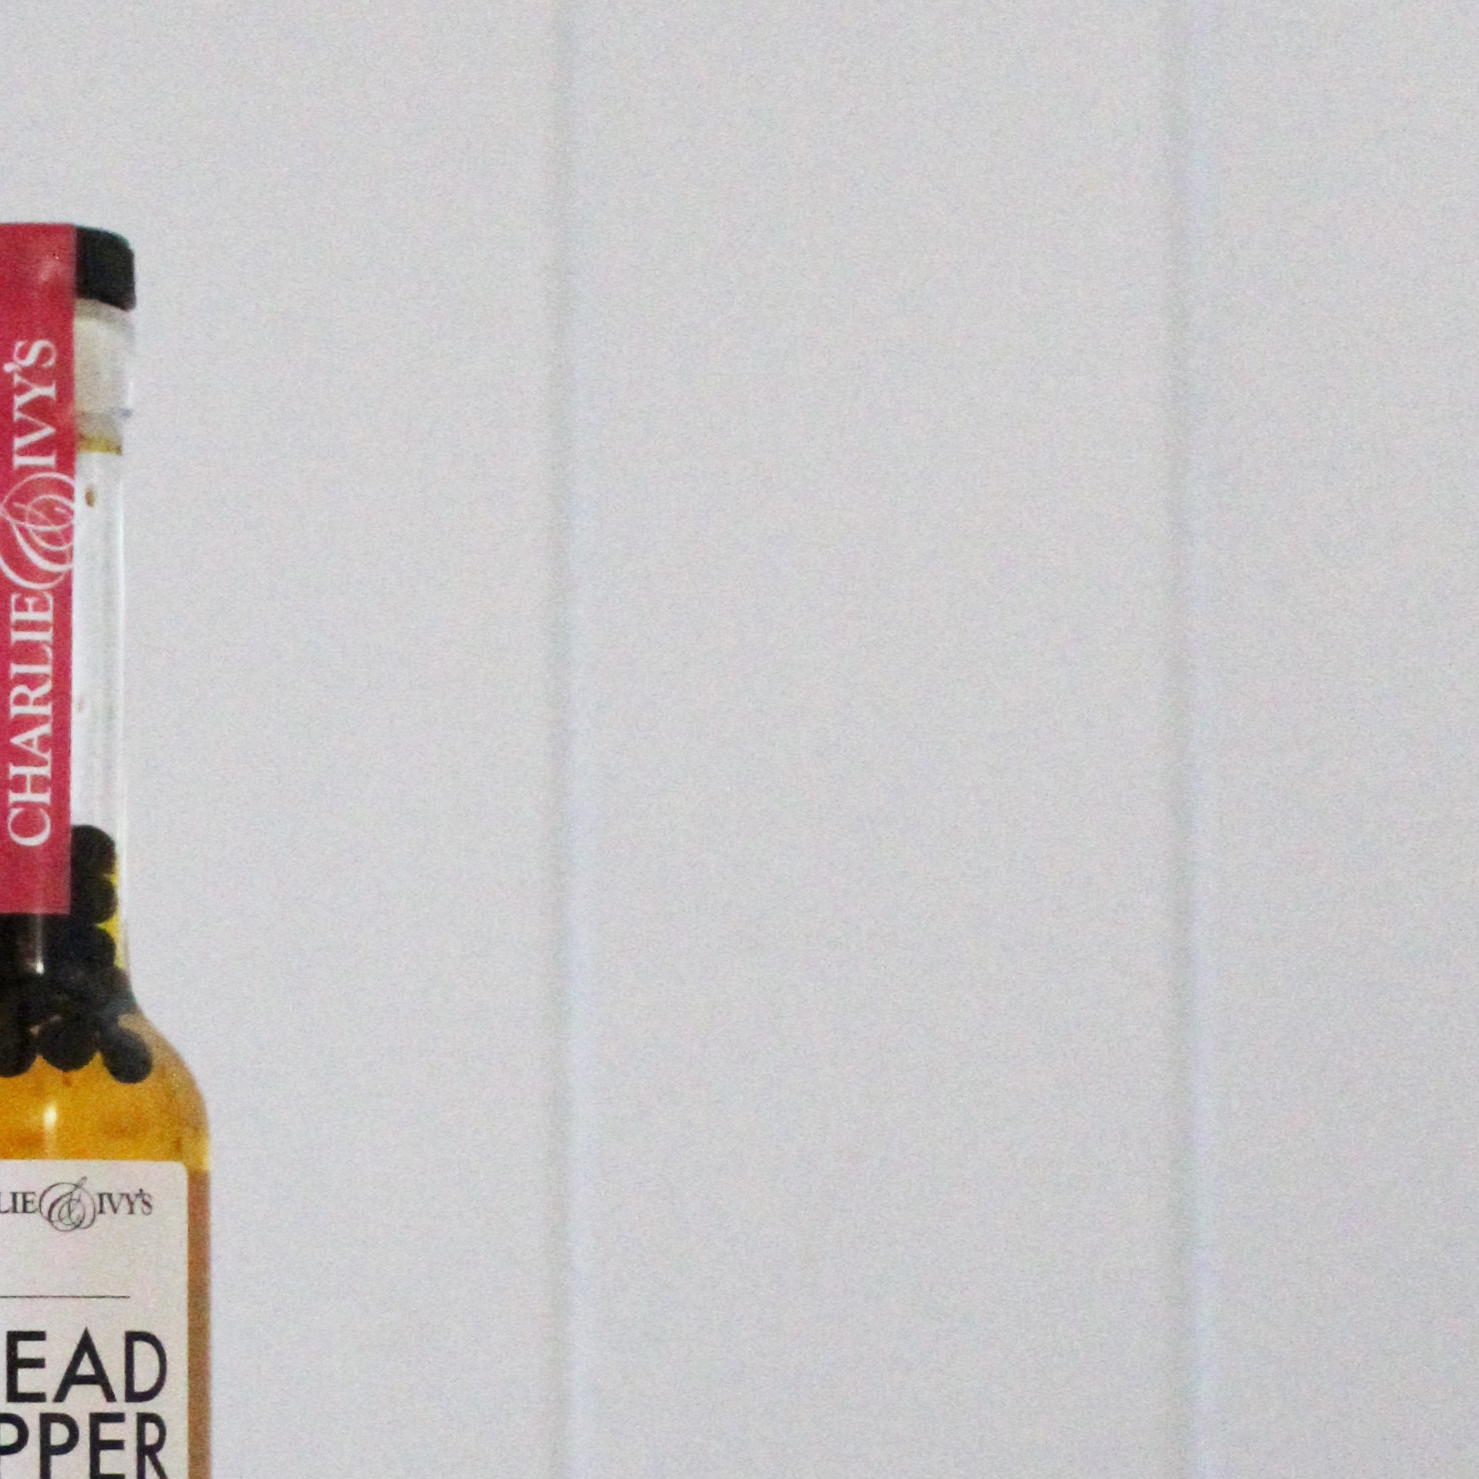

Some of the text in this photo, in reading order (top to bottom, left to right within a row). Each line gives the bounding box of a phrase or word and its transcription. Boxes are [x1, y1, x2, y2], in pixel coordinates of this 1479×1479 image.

[3, 338, 57, 470] IVY'S
[7, 592, 54, 847] CHARLIE
[98, 1188, 153, 1216] IVY'S
